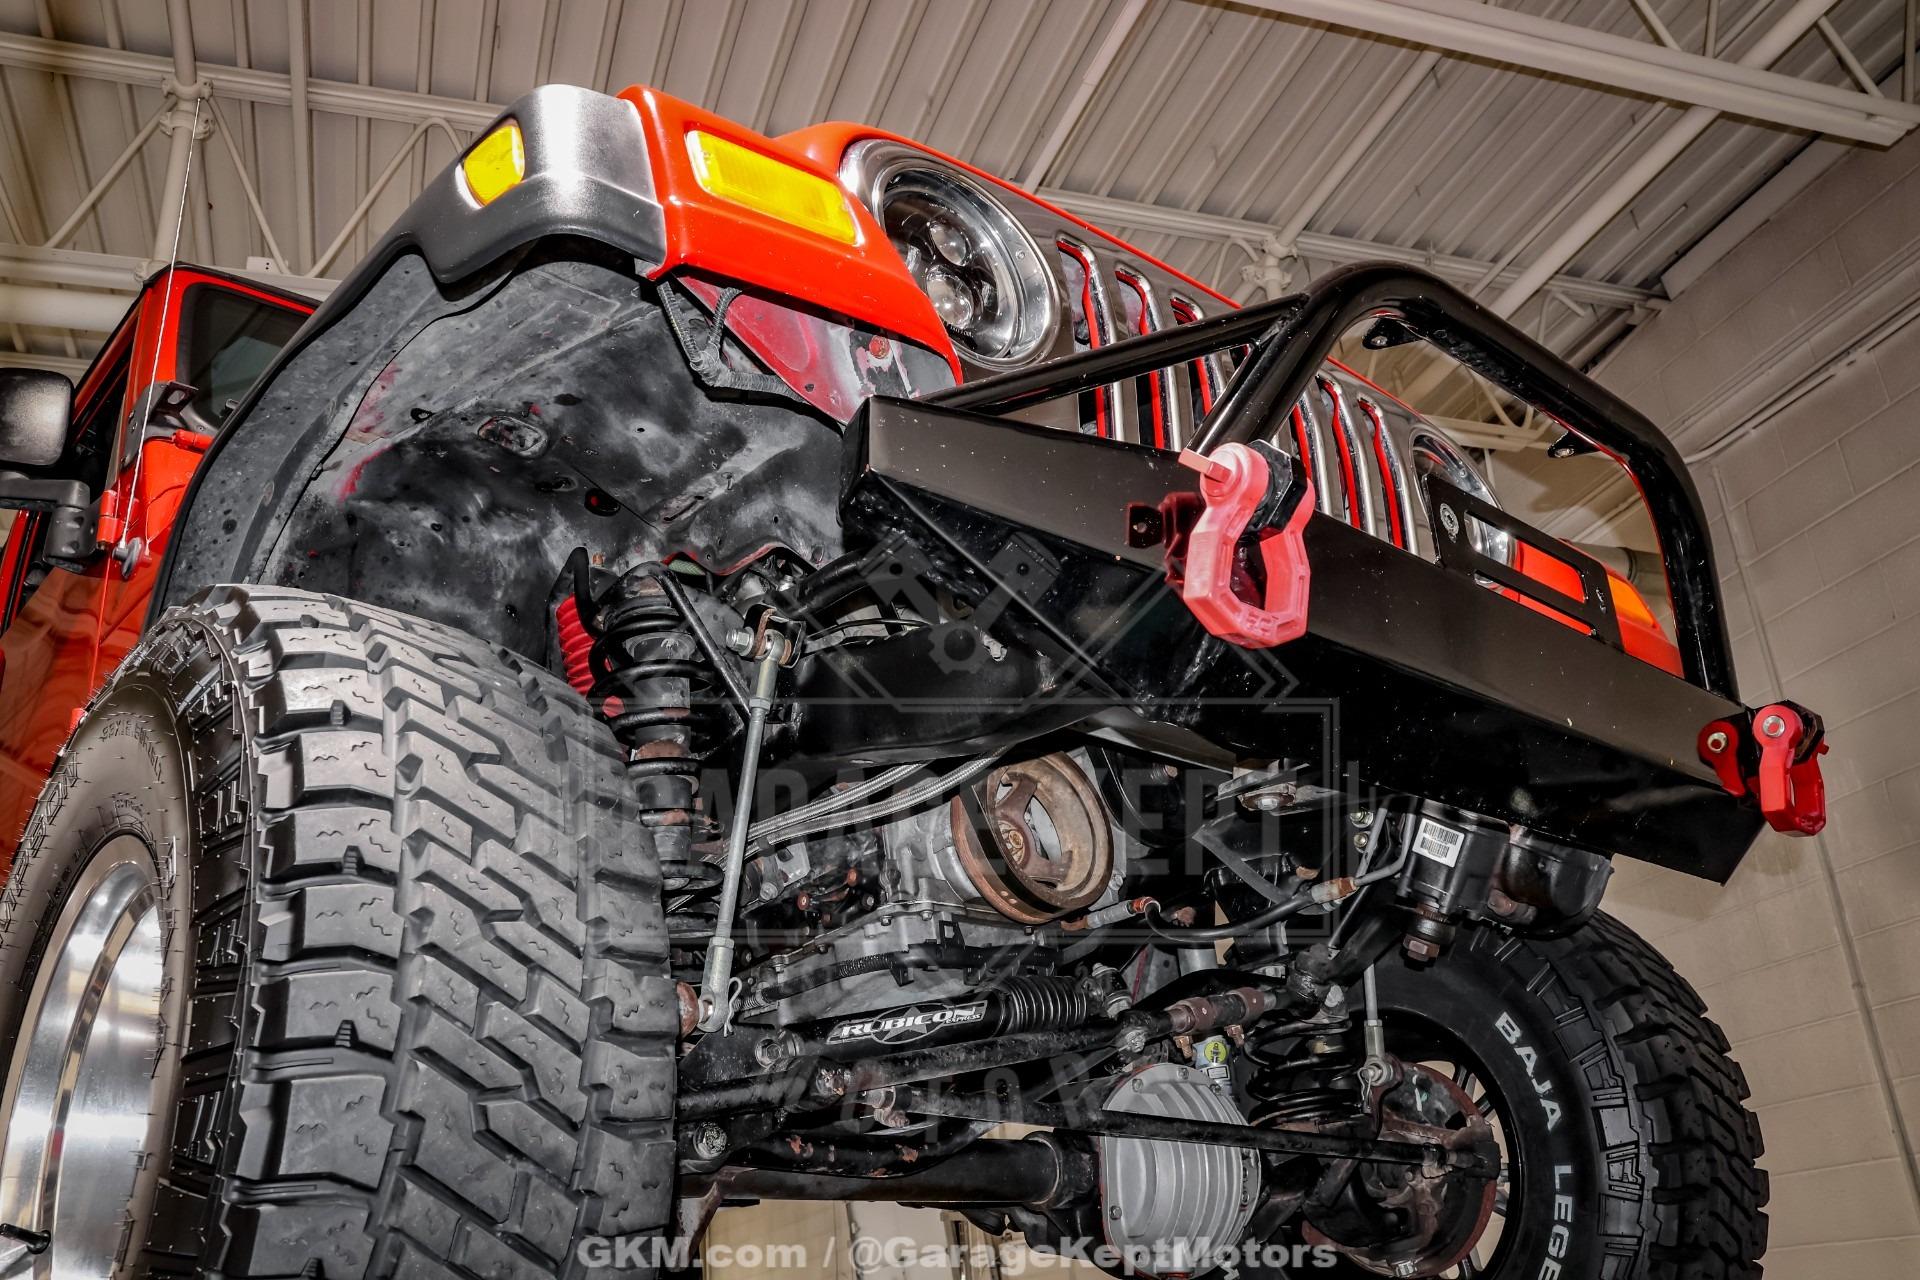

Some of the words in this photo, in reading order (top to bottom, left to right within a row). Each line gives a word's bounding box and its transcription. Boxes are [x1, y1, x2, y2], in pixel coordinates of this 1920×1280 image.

[840, 1007, 976, 1039] RUBICON
[945, 1012, 981, 1024] EXPRESS
[1495, 1011, 1562, 1131] BAJA
